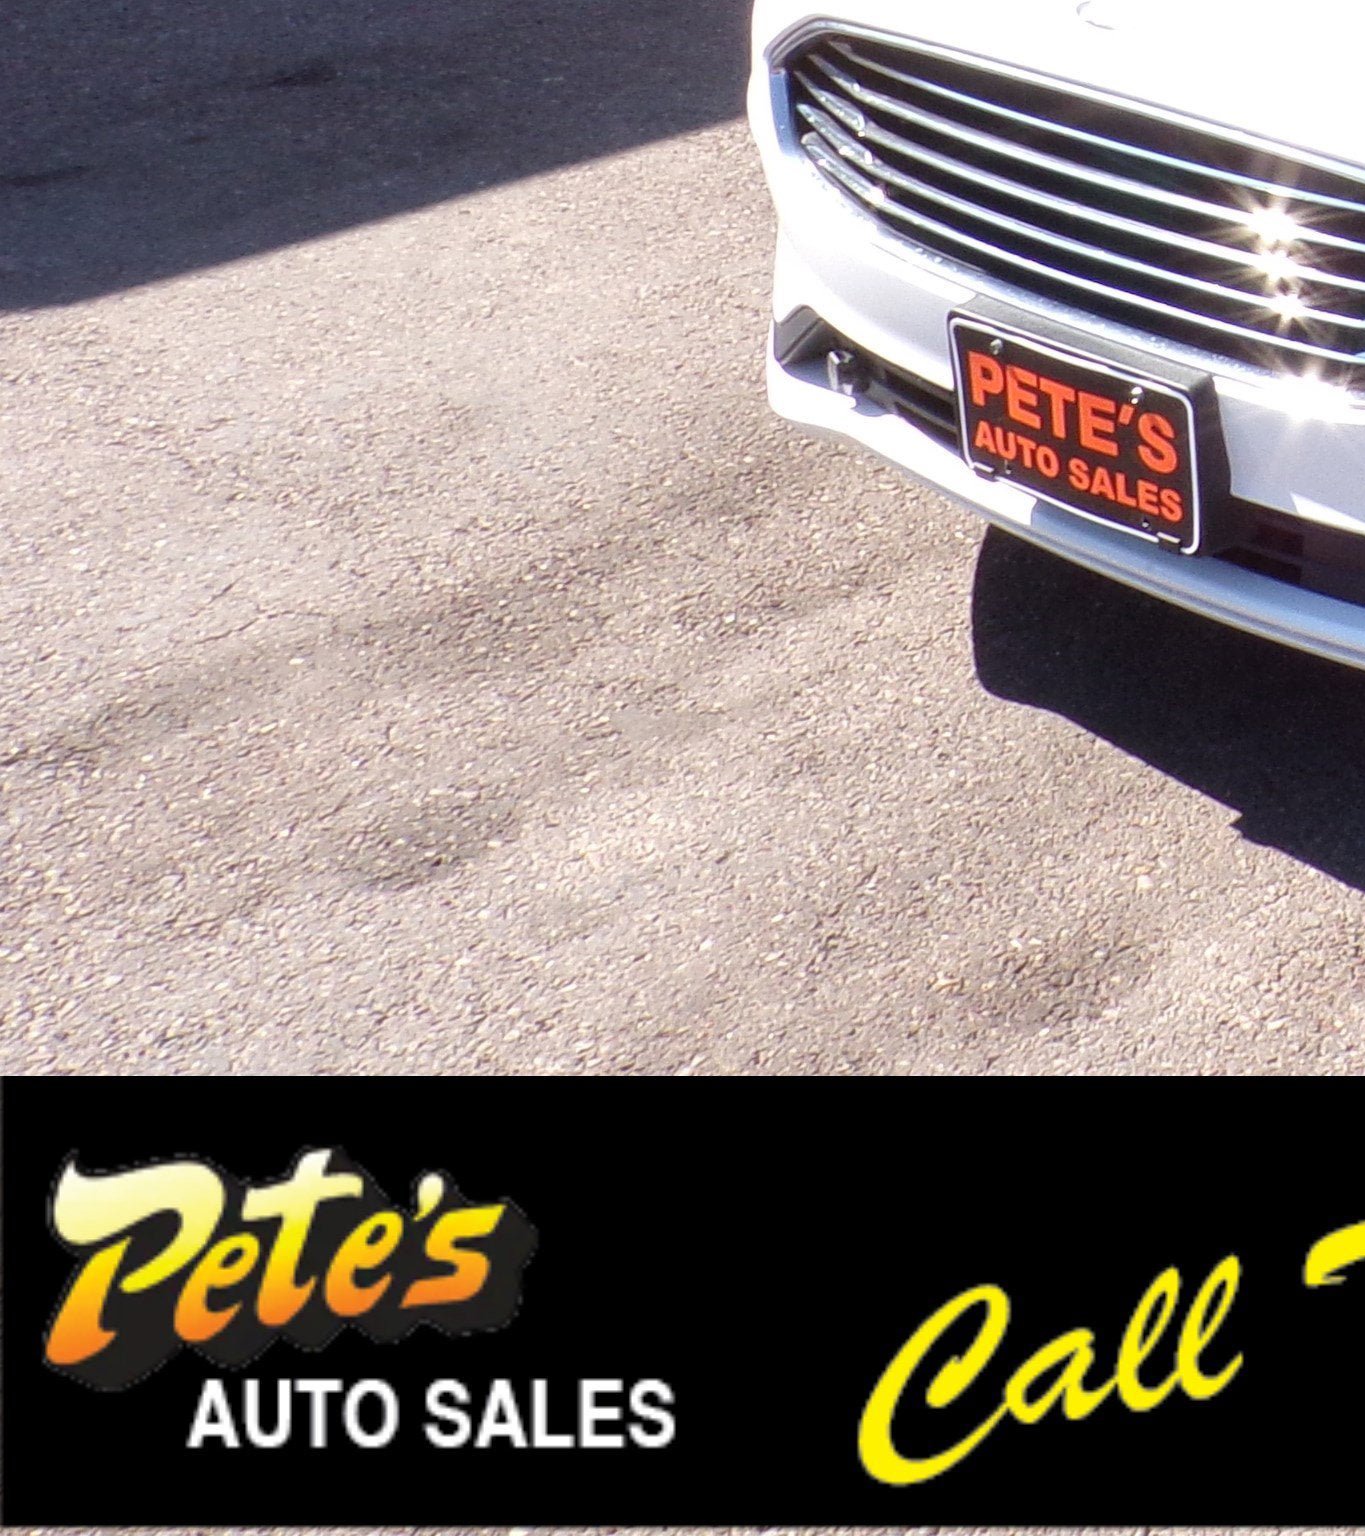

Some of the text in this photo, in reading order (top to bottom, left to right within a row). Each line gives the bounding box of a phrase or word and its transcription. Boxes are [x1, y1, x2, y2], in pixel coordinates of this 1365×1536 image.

[967, 351, 1178, 474] PETE'S
[974, 420, 1184, 522] AUTO SALES
